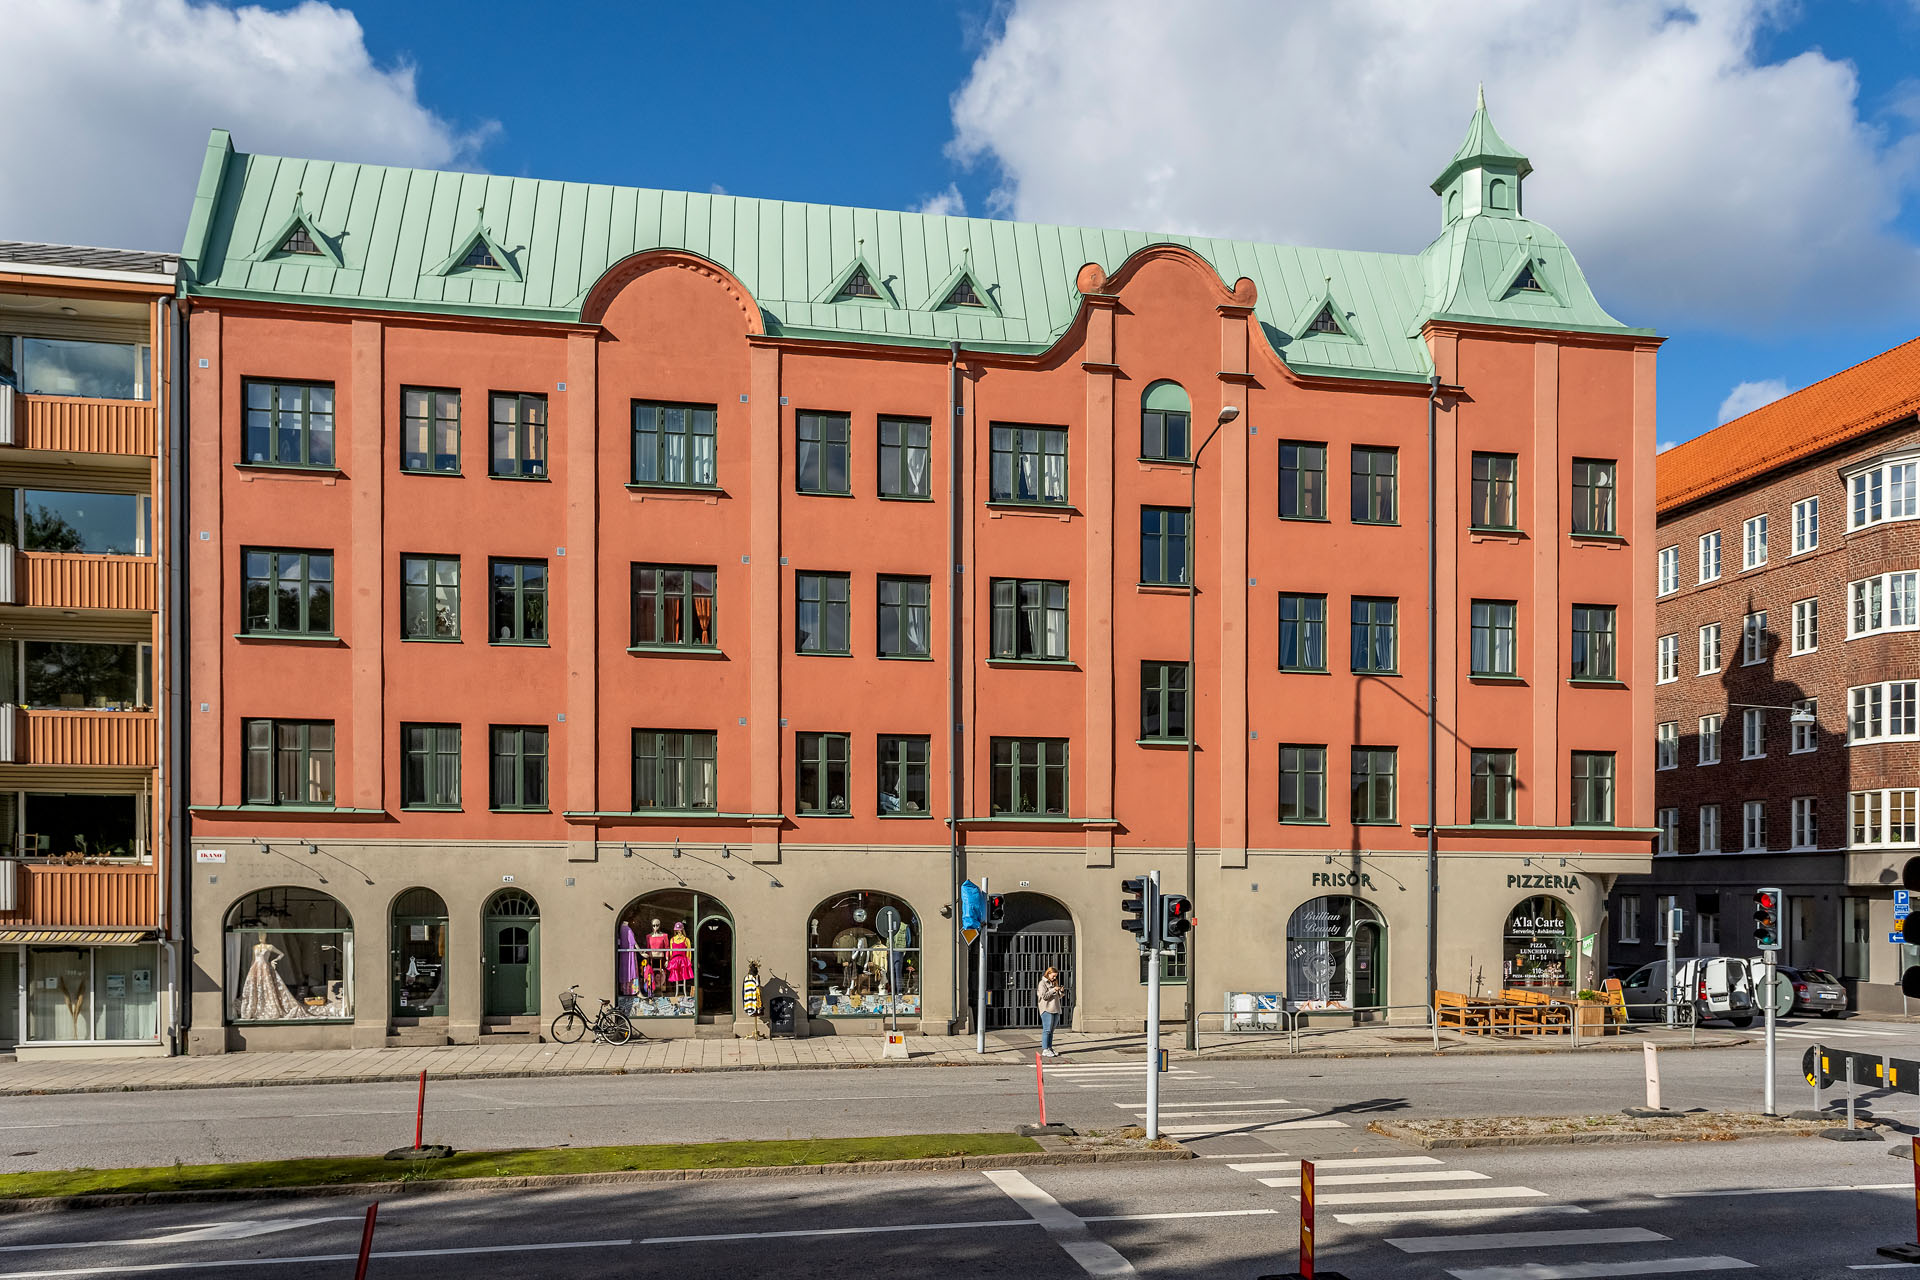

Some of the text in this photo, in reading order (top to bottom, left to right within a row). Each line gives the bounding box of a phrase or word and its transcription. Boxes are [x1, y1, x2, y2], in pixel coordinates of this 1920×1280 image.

[1312, 870, 1371, 887] FRISÖR
[1507, 874, 1581, 889] PIZZERIA
[1898, 892, 1907, 904] P
[1303, 922, 1341, 935] Beauty
[1535, 916, 1565, 928] Carte
